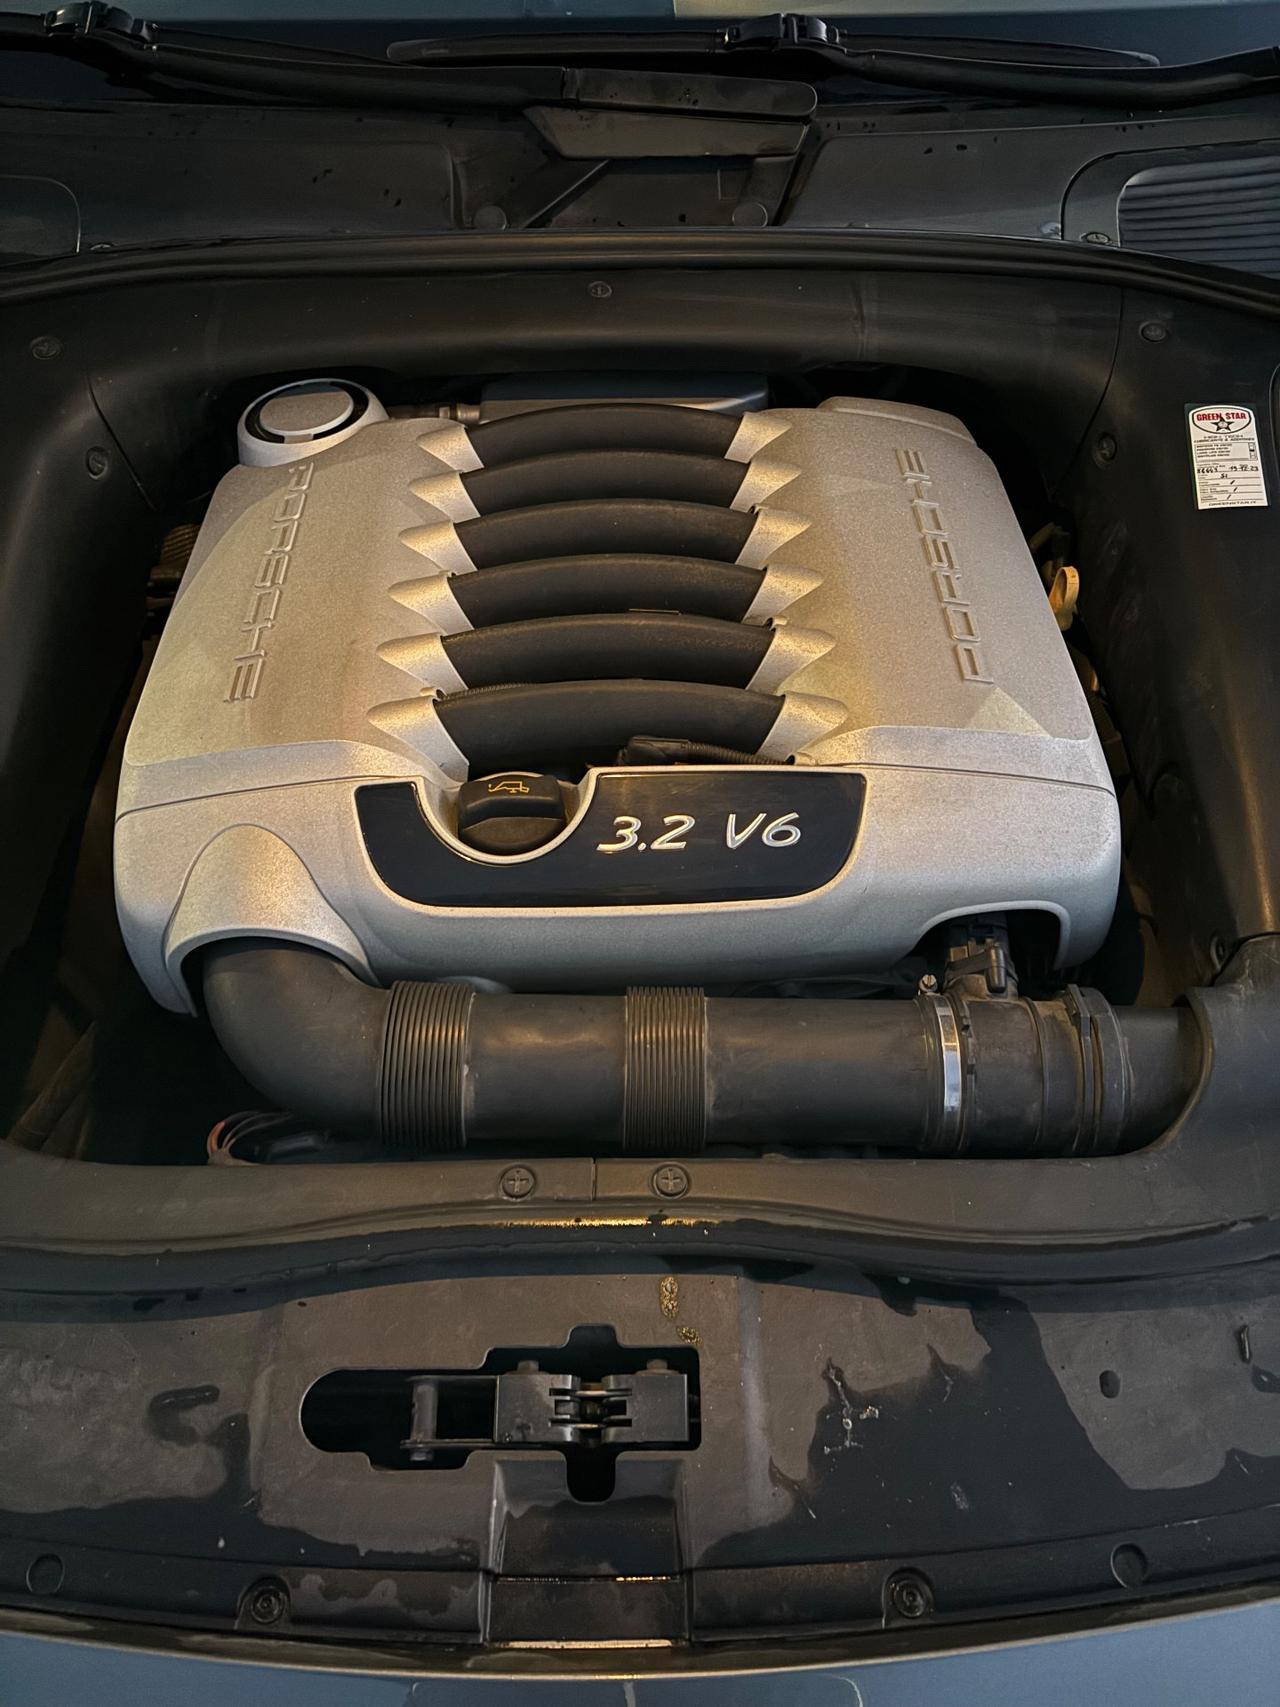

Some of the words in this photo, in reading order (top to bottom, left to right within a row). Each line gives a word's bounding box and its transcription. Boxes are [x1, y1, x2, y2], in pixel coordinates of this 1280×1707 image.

[1196, 413, 1222, 421] GREEN
[1225, 412, 1247, 420] STAR
[225, 462, 314, 703] PORSCHE
[895, 449, 994, 684] PORSCHE
[597, 814, 696, 851] 3.2
[726, 812, 801, 849] V6
